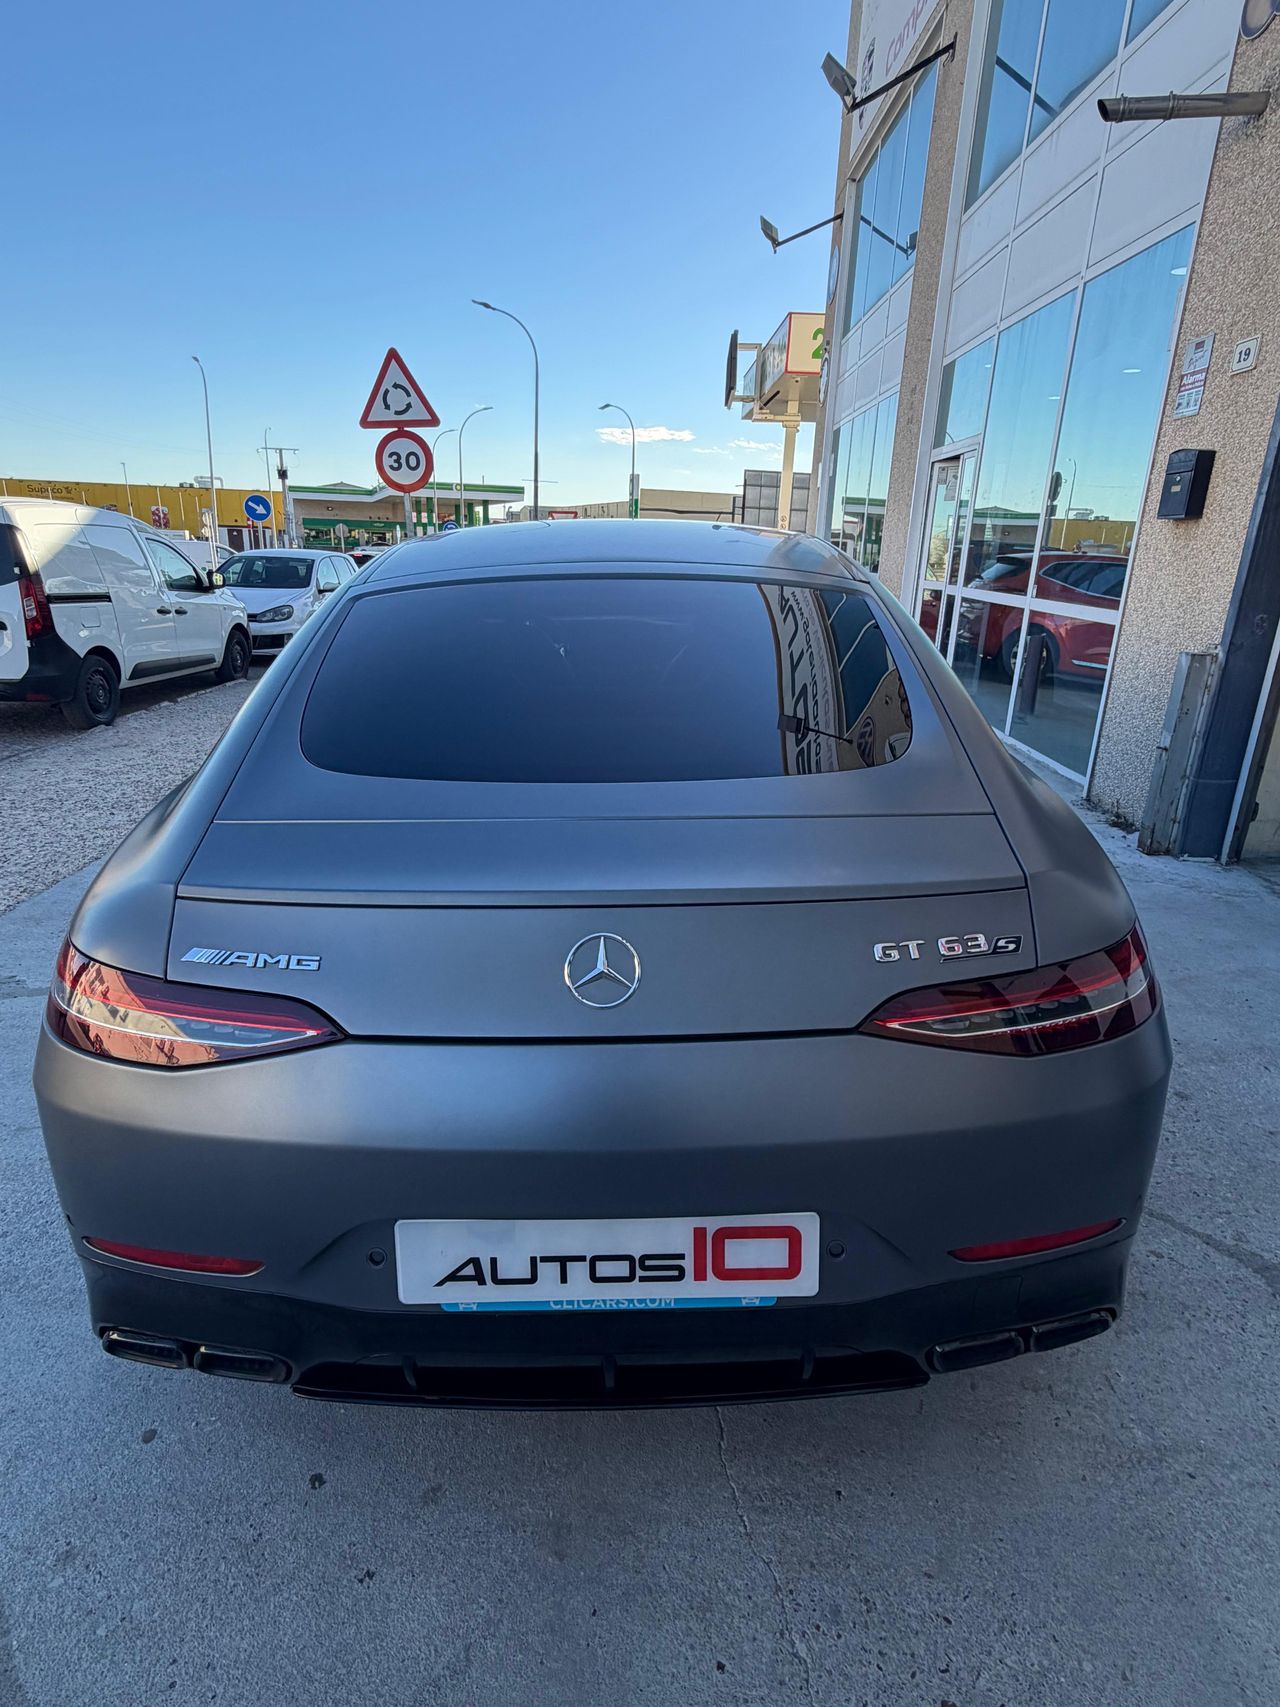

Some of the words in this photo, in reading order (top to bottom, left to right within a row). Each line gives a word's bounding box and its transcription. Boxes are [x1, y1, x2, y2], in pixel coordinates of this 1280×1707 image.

[1236, 347, 1251, 364] 19
[388, 451, 420, 471] 30
[223, 951, 322, 971] AMG
[873, 940, 925, 962] GT
[549, 1297, 675, 1309] CLICARS.COM
